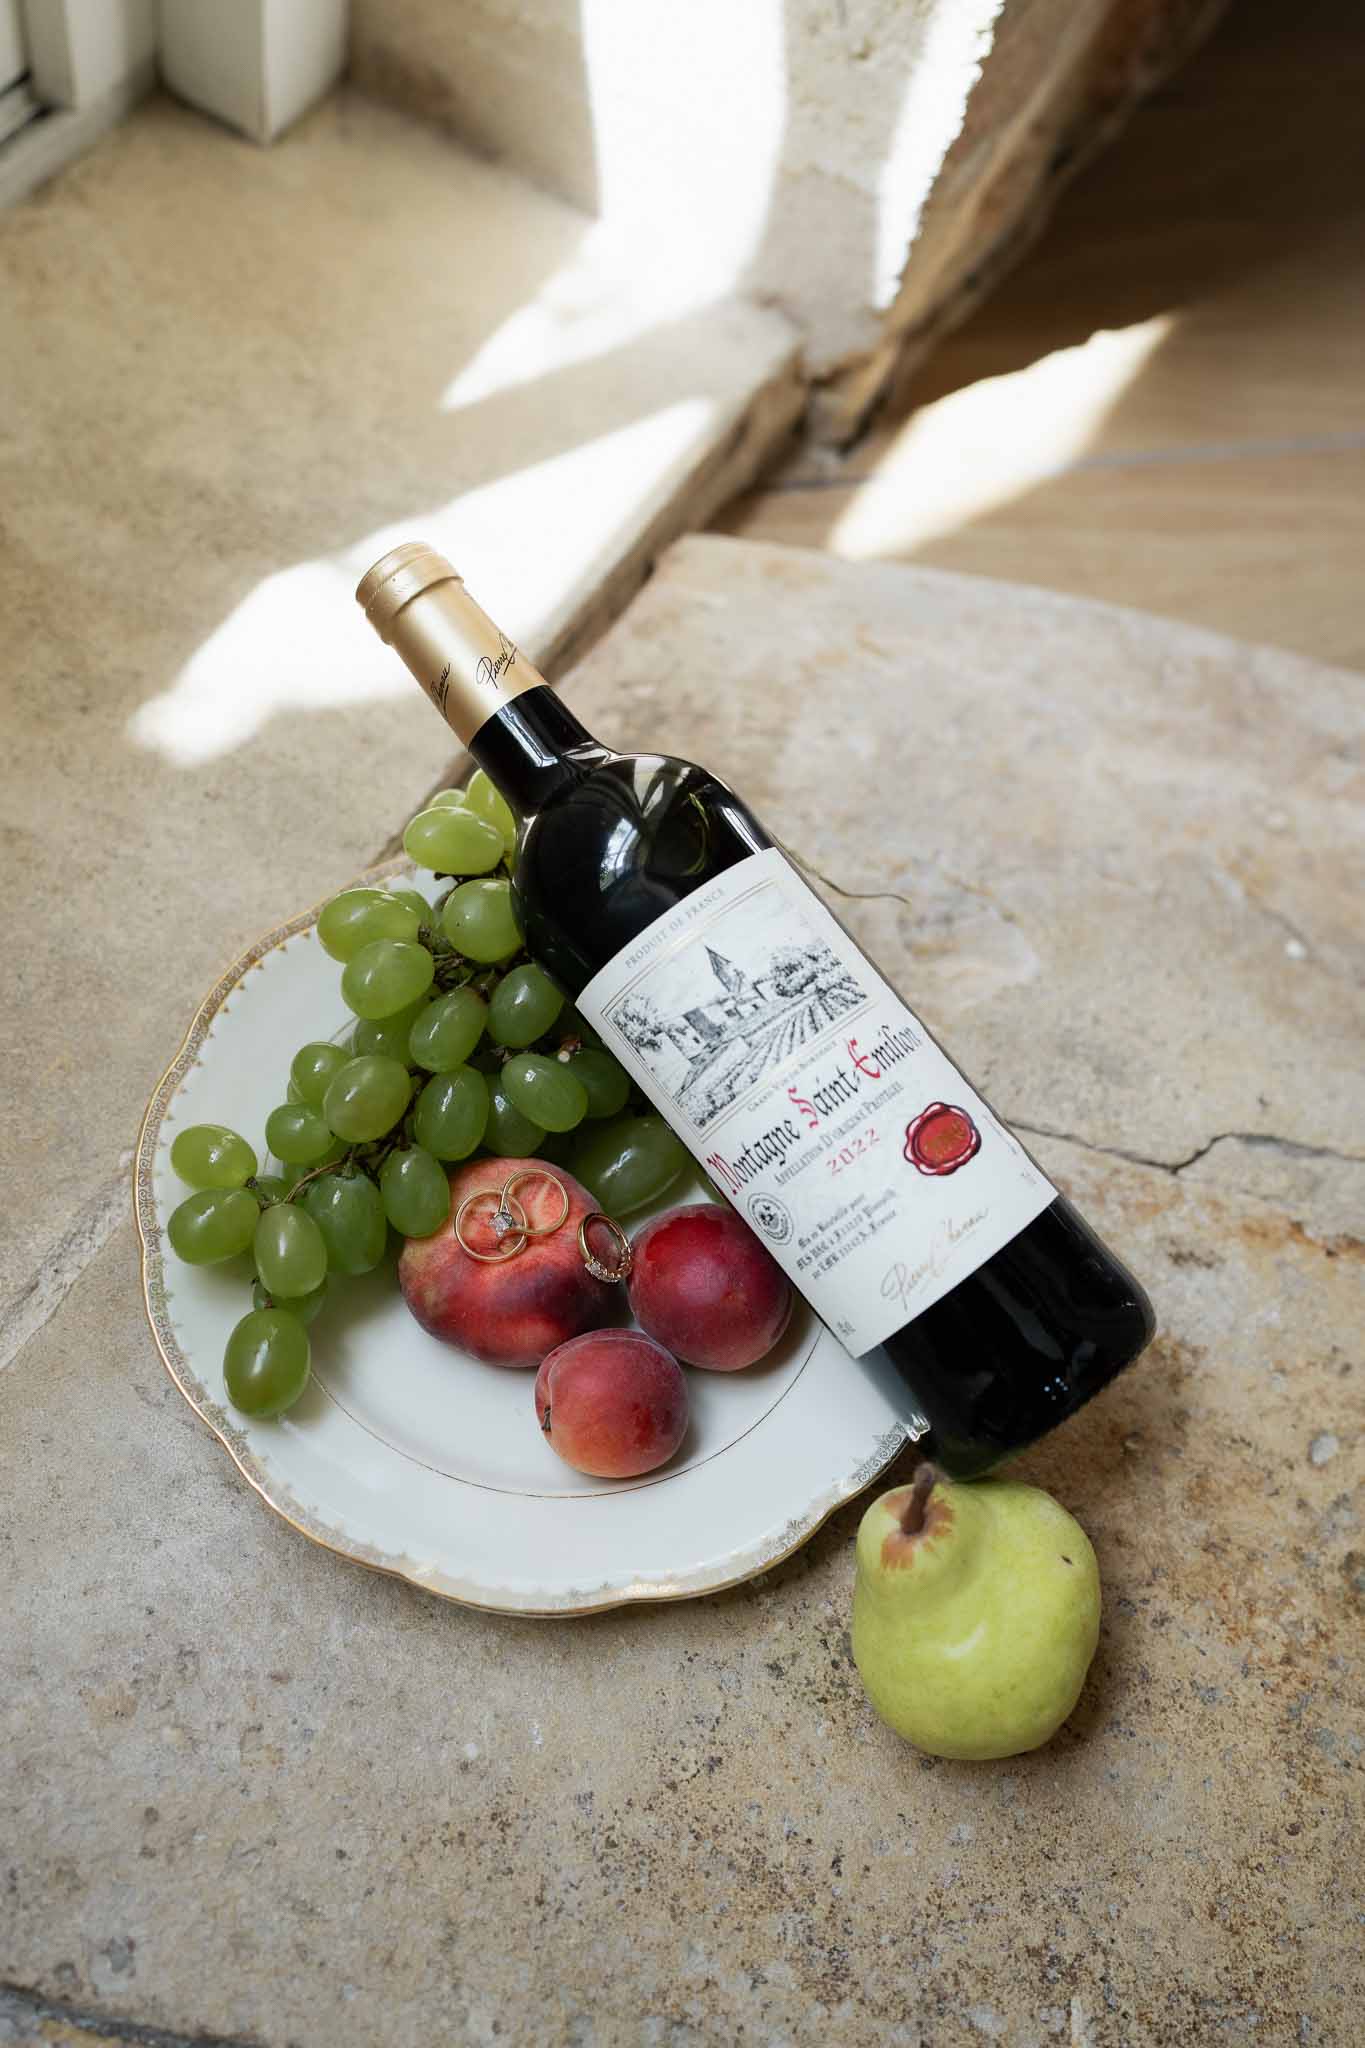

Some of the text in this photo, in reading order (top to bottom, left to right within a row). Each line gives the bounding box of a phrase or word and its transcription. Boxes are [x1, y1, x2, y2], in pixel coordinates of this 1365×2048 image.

[625, 928, 668, 969] PRODUIT
[706, 1119, 800, 1195] Montagne
[826, 1127, 880, 1176] 2022
